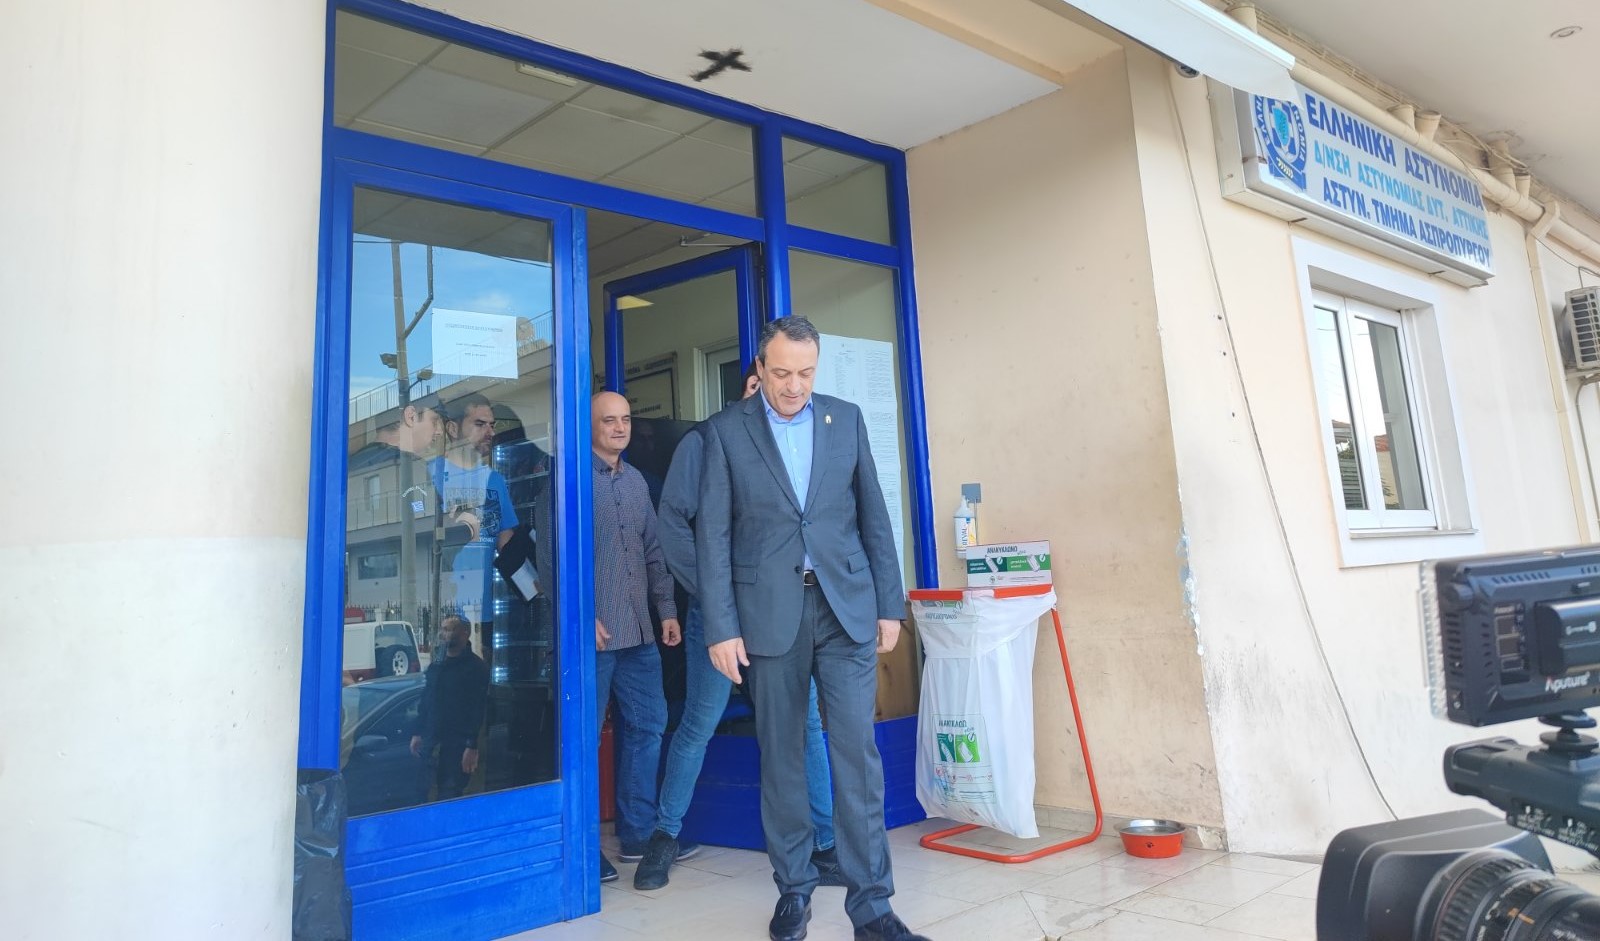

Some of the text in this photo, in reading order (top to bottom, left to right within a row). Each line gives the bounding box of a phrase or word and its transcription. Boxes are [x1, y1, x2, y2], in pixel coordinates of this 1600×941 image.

[1305, 93, 1484, 211] ΕΛΛΗΝΙΚΗ ΑΣΤΥΝΟΜΙΑ
[1314, 140, 1351, 177] Δ/ΝΣΗ
[1358, 162, 1425, 211] ΑΣΤΥΝΟΜΙΑΣ
[1427, 195, 1448, 222] ΔΥΤ.
[1452, 206, 1488, 240] ΑΤΤΙΚΗΣ
[1322, 177, 1490, 267] ΑΣΤΥΝ. ΤΜΗΜΑ ΑΣΠΡΟΠΥΡΓΟΥ
